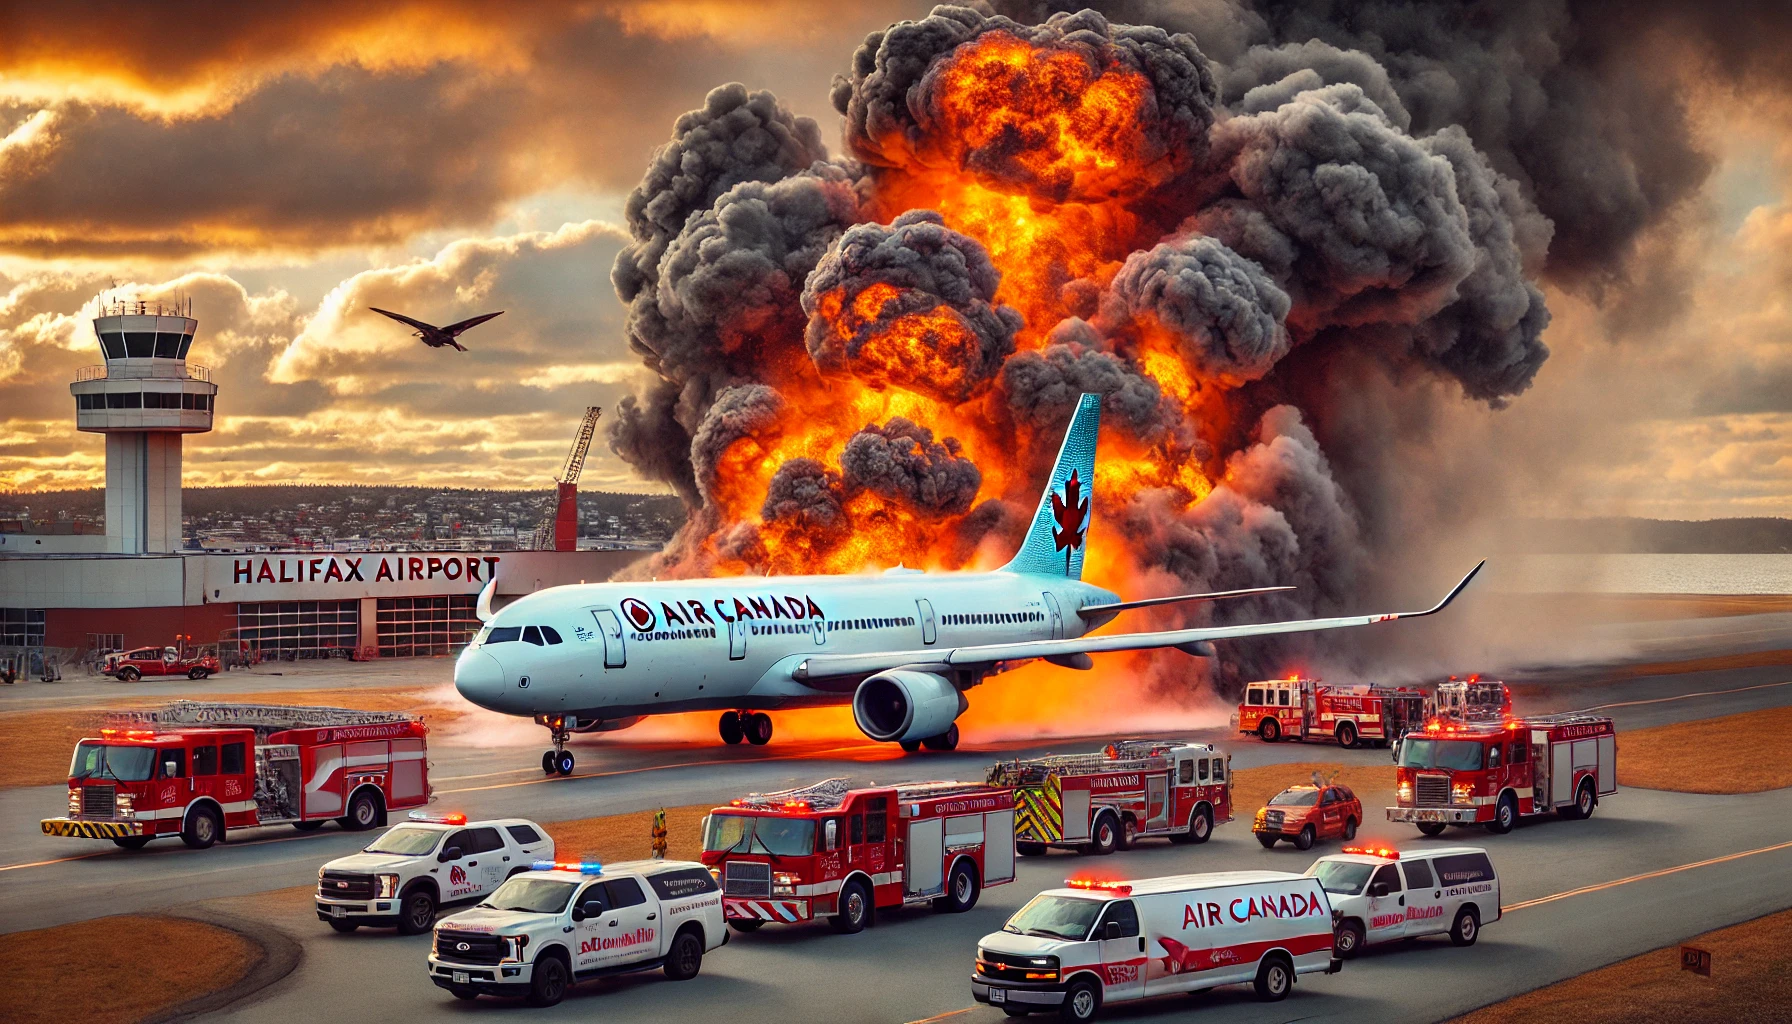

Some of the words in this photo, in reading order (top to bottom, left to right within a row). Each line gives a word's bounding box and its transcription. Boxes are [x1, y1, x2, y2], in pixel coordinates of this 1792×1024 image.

[233, 555, 364, 584] HALIFAX
[375, 556, 500, 584] AIRPORT
[660, 599, 715, 627] AIR
[713, 594, 825, 623] CANADA
[1182, 901, 1224, 930] AIR
[1228, 891, 1325, 924] CANADA
